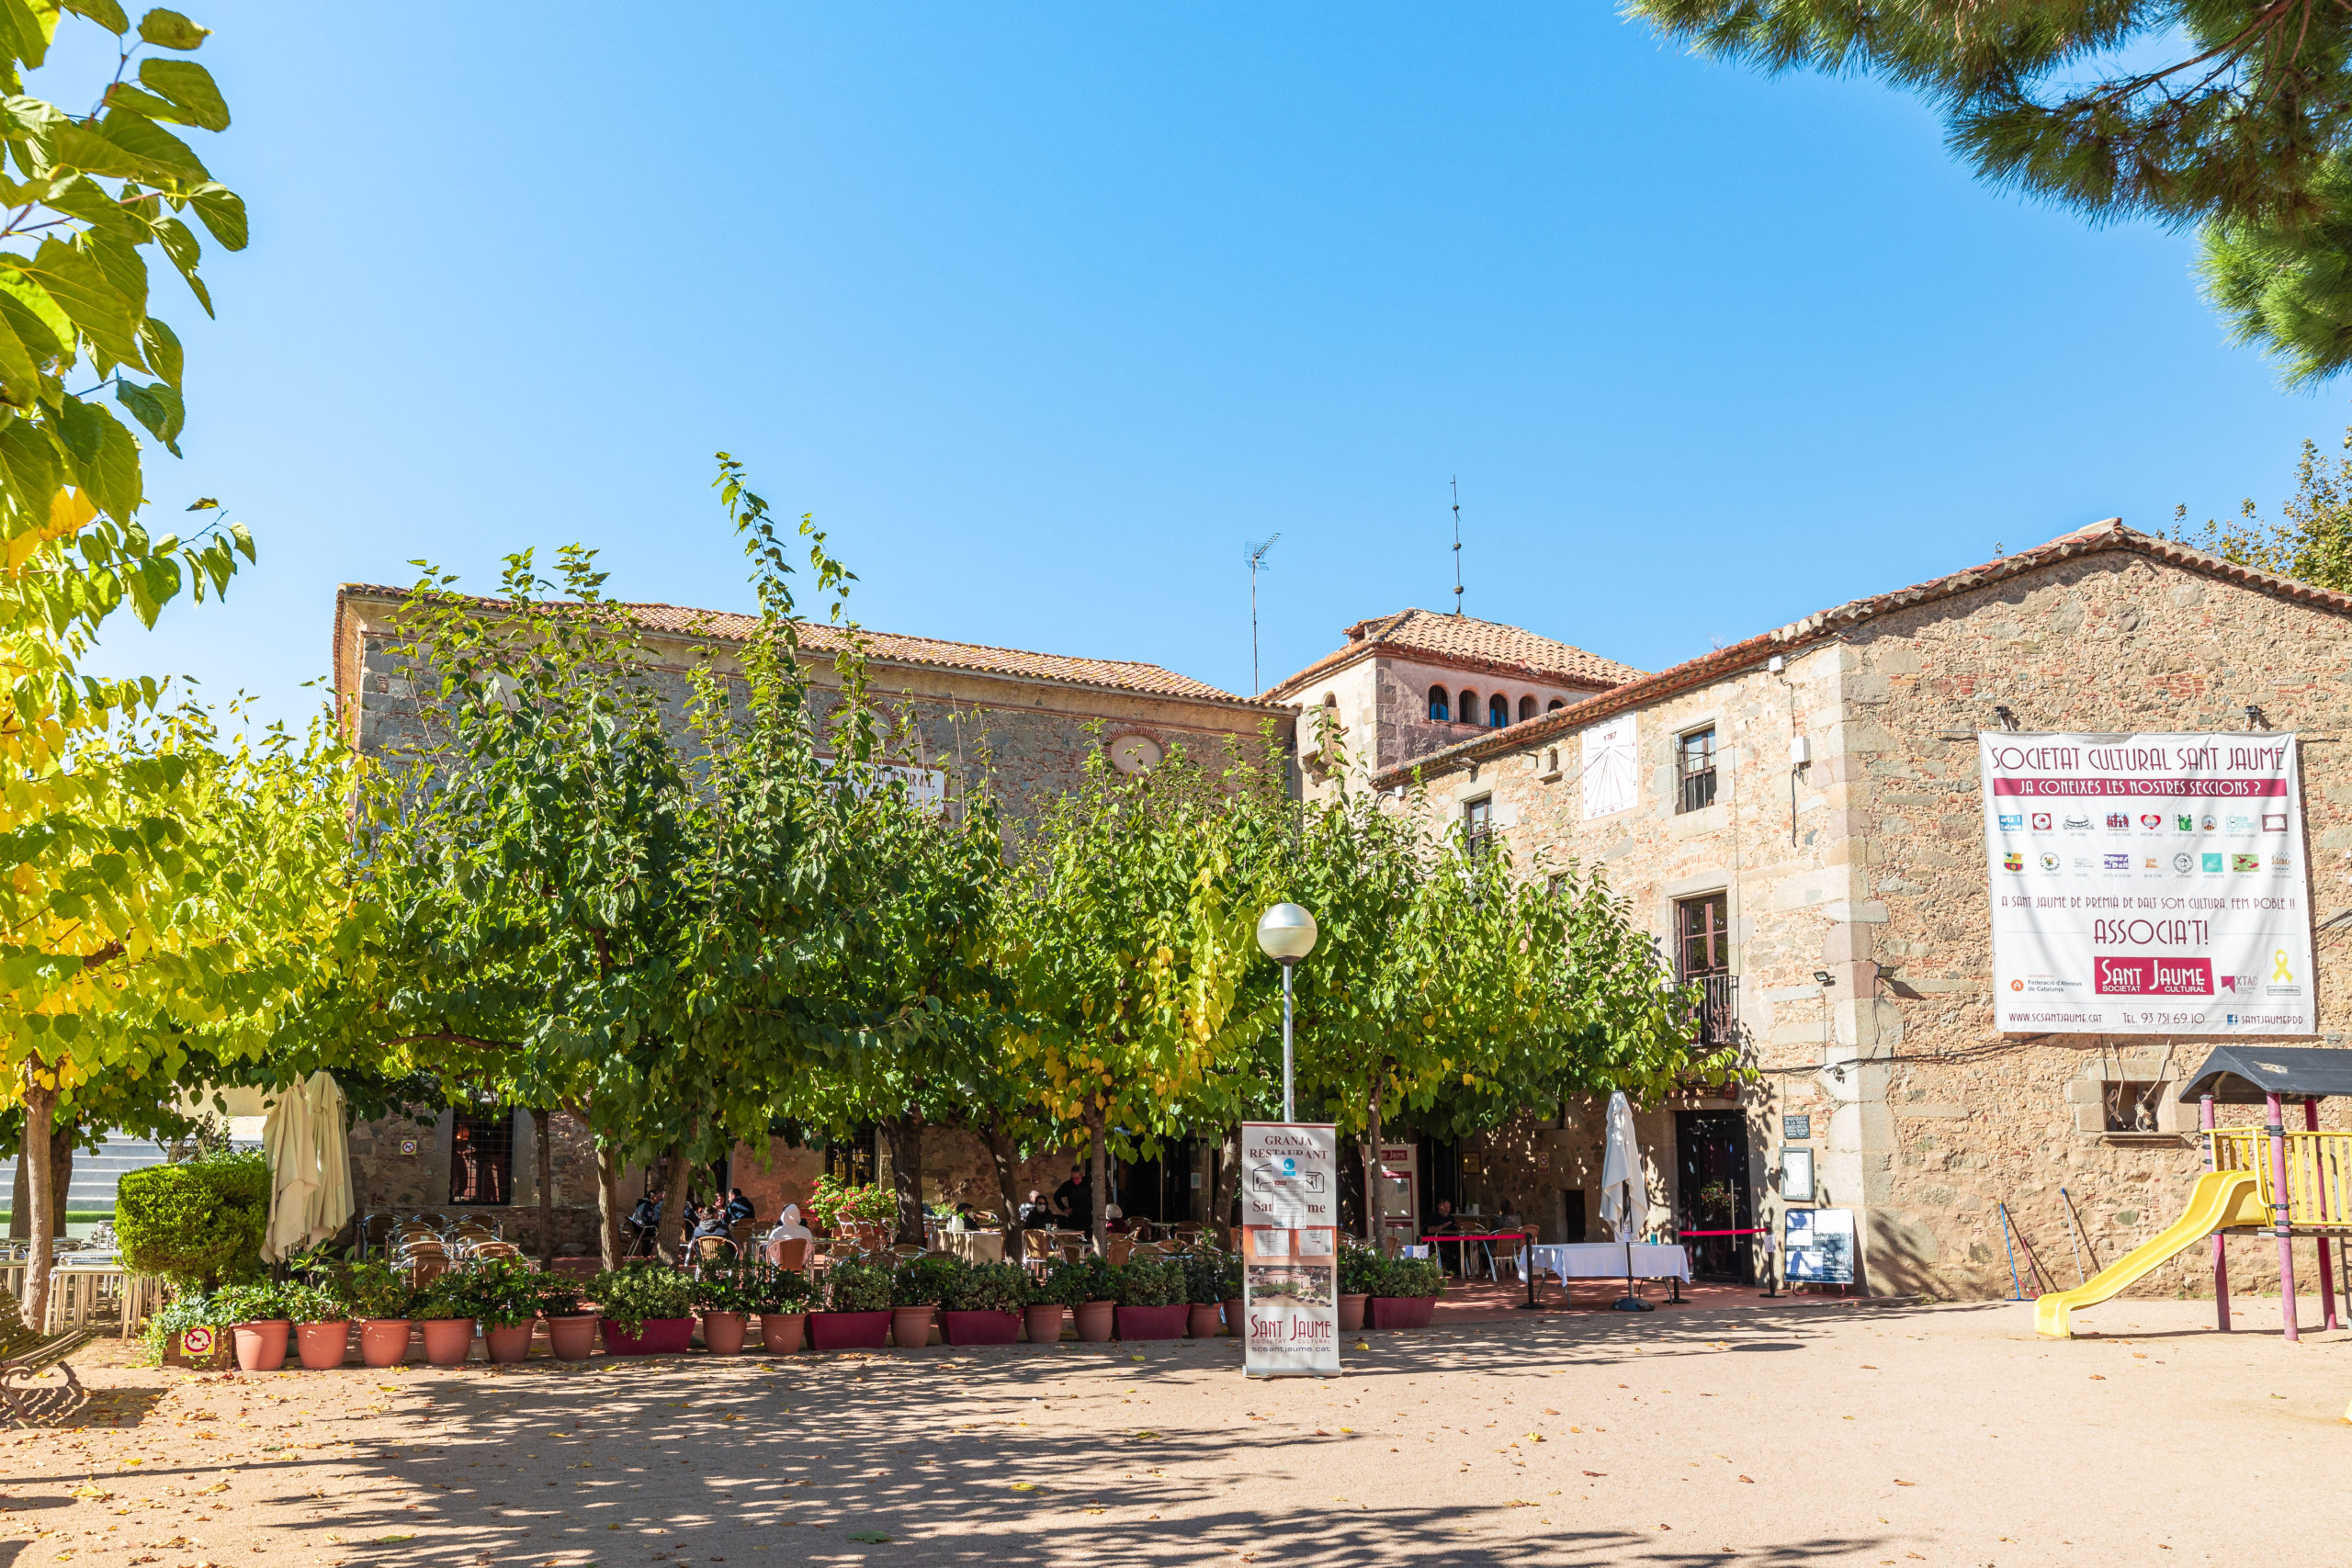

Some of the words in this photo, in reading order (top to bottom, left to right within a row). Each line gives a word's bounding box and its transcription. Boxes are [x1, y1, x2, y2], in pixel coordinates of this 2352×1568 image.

[1992, 747, 2080, 770] SOCIETAT
[2088, 749, 2172, 771] CULTURAL
[2177, 748, 2219, 770] SANT
[2227, 748, 2284, 770] JAUME
[2019, 781, 2033, 795] JA
[2039, 781, 2101, 795] CONEIXES
[2107, 781, 2124, 795] LES
[2130, 781, 2186, 795] NOSTRES
[2190, 781, 2249, 795] SECCIONS
[2002, 897, 2007, 908] A
[2012, 897, 2031, 908] SANT
[2036, 897, 2066, 908] JAUME
[2070, 897, 2081, 908] DE
[2123, 897, 2133, 908] DE
[2138, 897, 2156, 908] DALT
[2161, 897, 2185, 908] SOM
[2232, 897, 2249, 909] FEM
[2254, 897, 2286, 909] POBLE
[2094, 919, 2208, 945] ASSOCIA'T!
[2102, 959, 2143, 985] SANT
[2149, 959, 2205, 991] JAUME
[2009, 1012, 2102, 1023] WWW.SCSANTJAUME.CAT
[2141, 1013, 2154, 1024] 93
[2157, 1013, 2170, 1024] 751
[2174, 1013, 2187, 1024] 69
[2191, 1013, 2205, 1024] 10
[2242, 1015, 2303, 1025] SANTJAUMEPDD
[1264, 1135, 1313, 1146] GRANJA
[1250, 1314, 1283, 1338] SANT
[1290, 1314, 1331, 1341] JAUME
